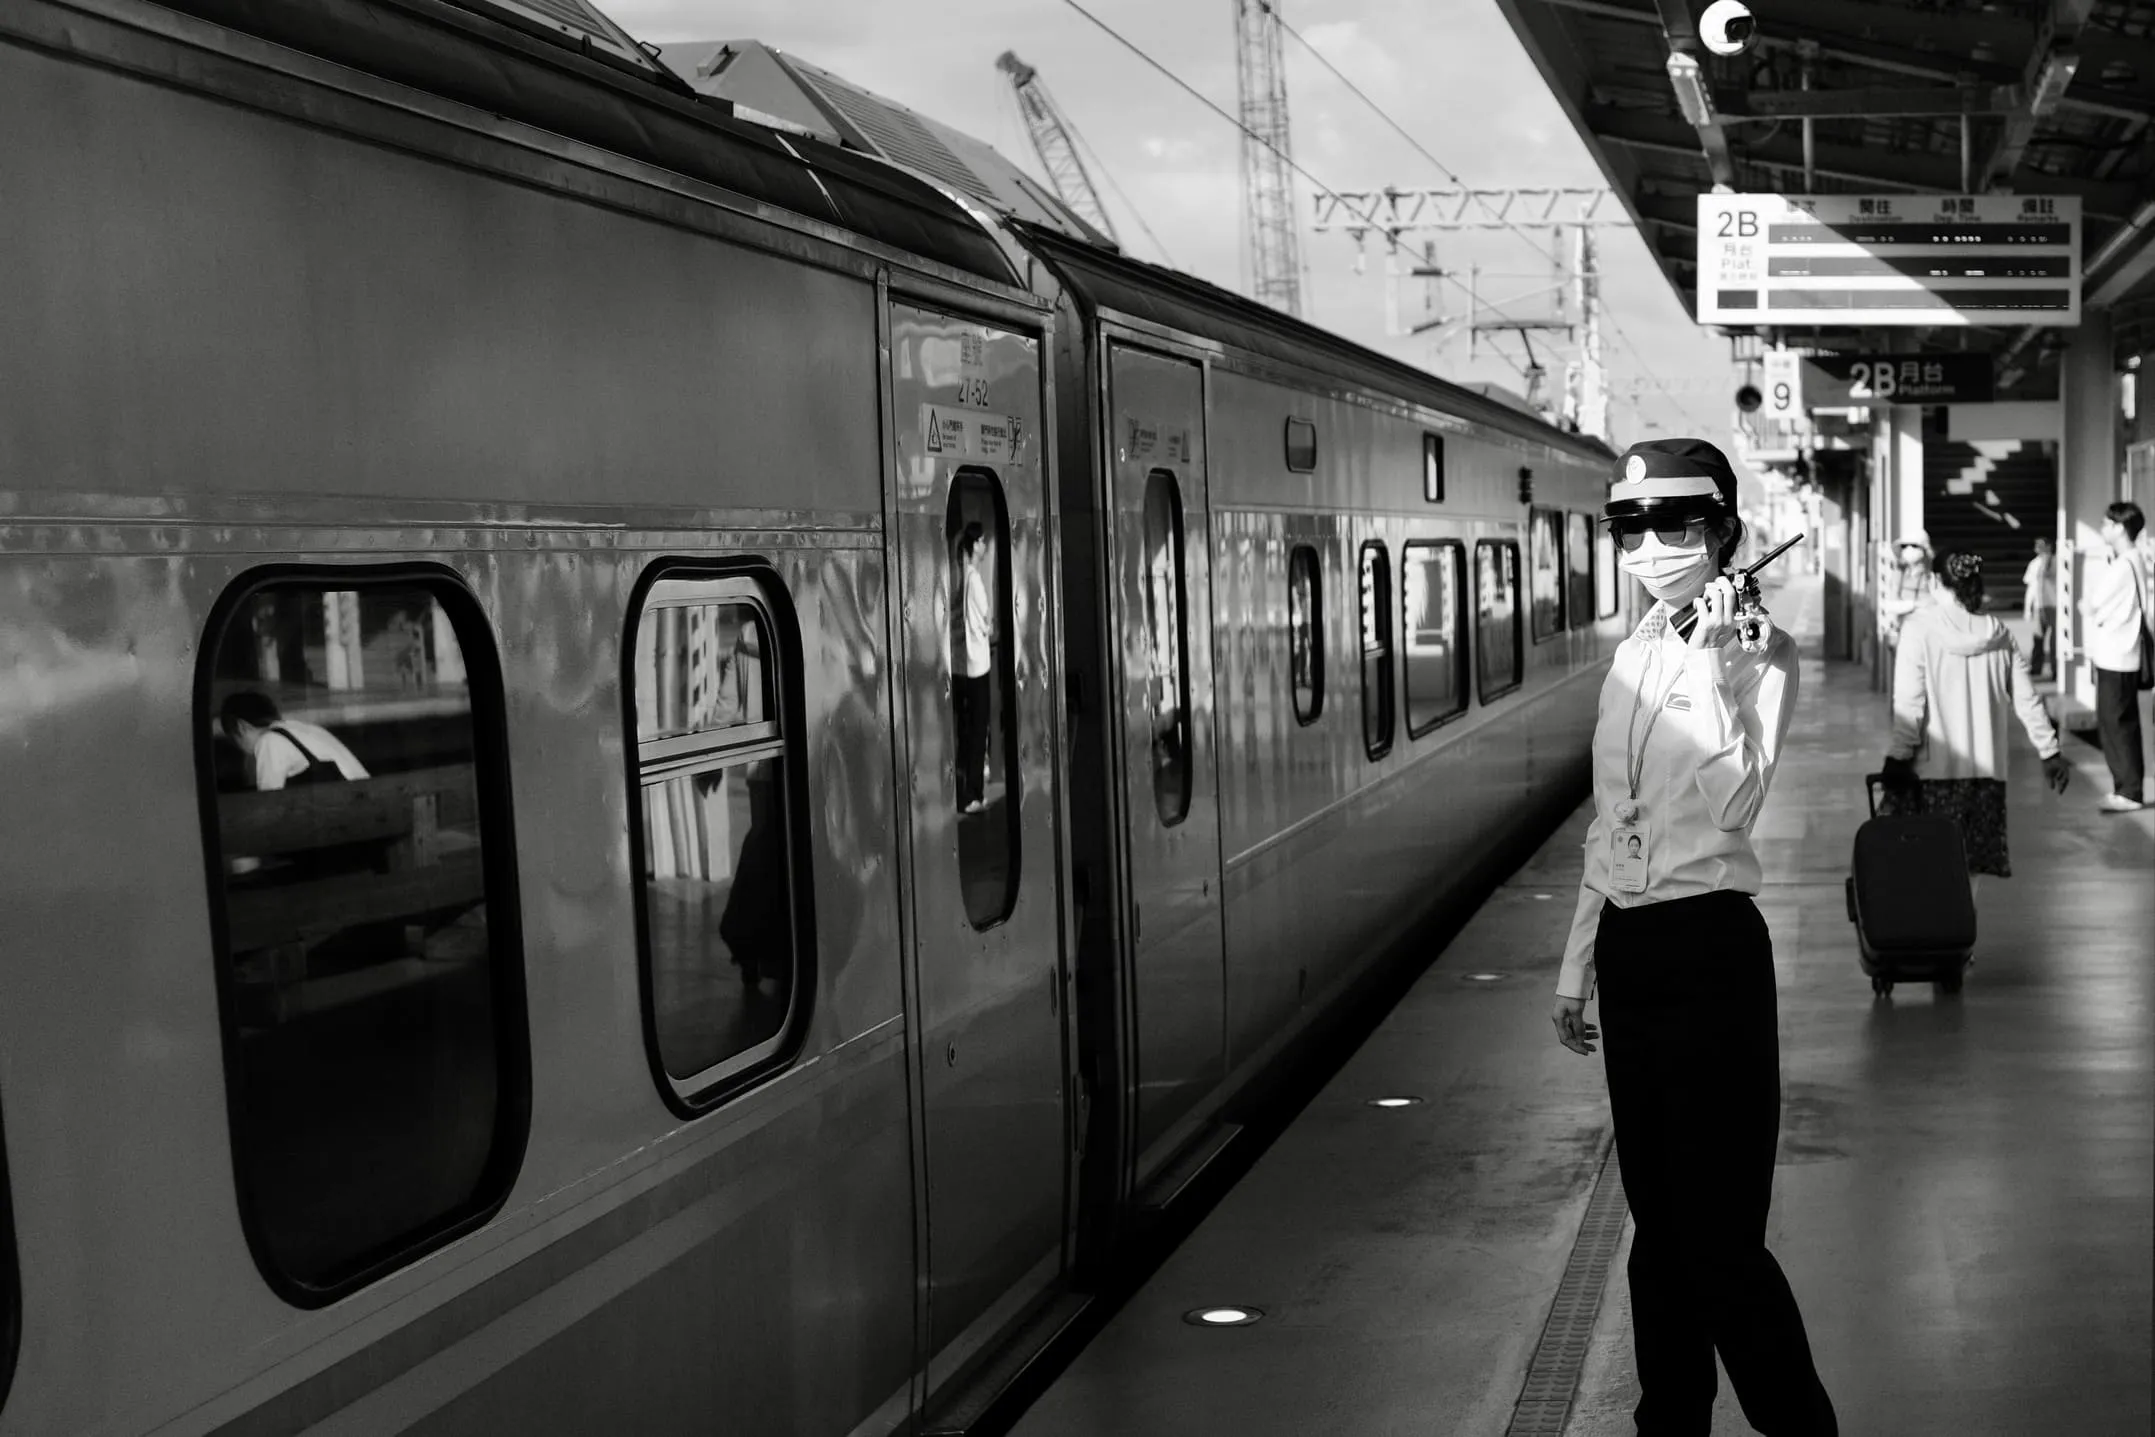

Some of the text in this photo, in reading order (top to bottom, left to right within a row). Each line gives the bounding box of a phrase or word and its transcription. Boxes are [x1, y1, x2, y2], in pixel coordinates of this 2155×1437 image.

[1717, 211, 1759, 237] 2B
[1849, 361, 1943, 398] 2B 月台
[1774, 382, 1790, 410] 9
